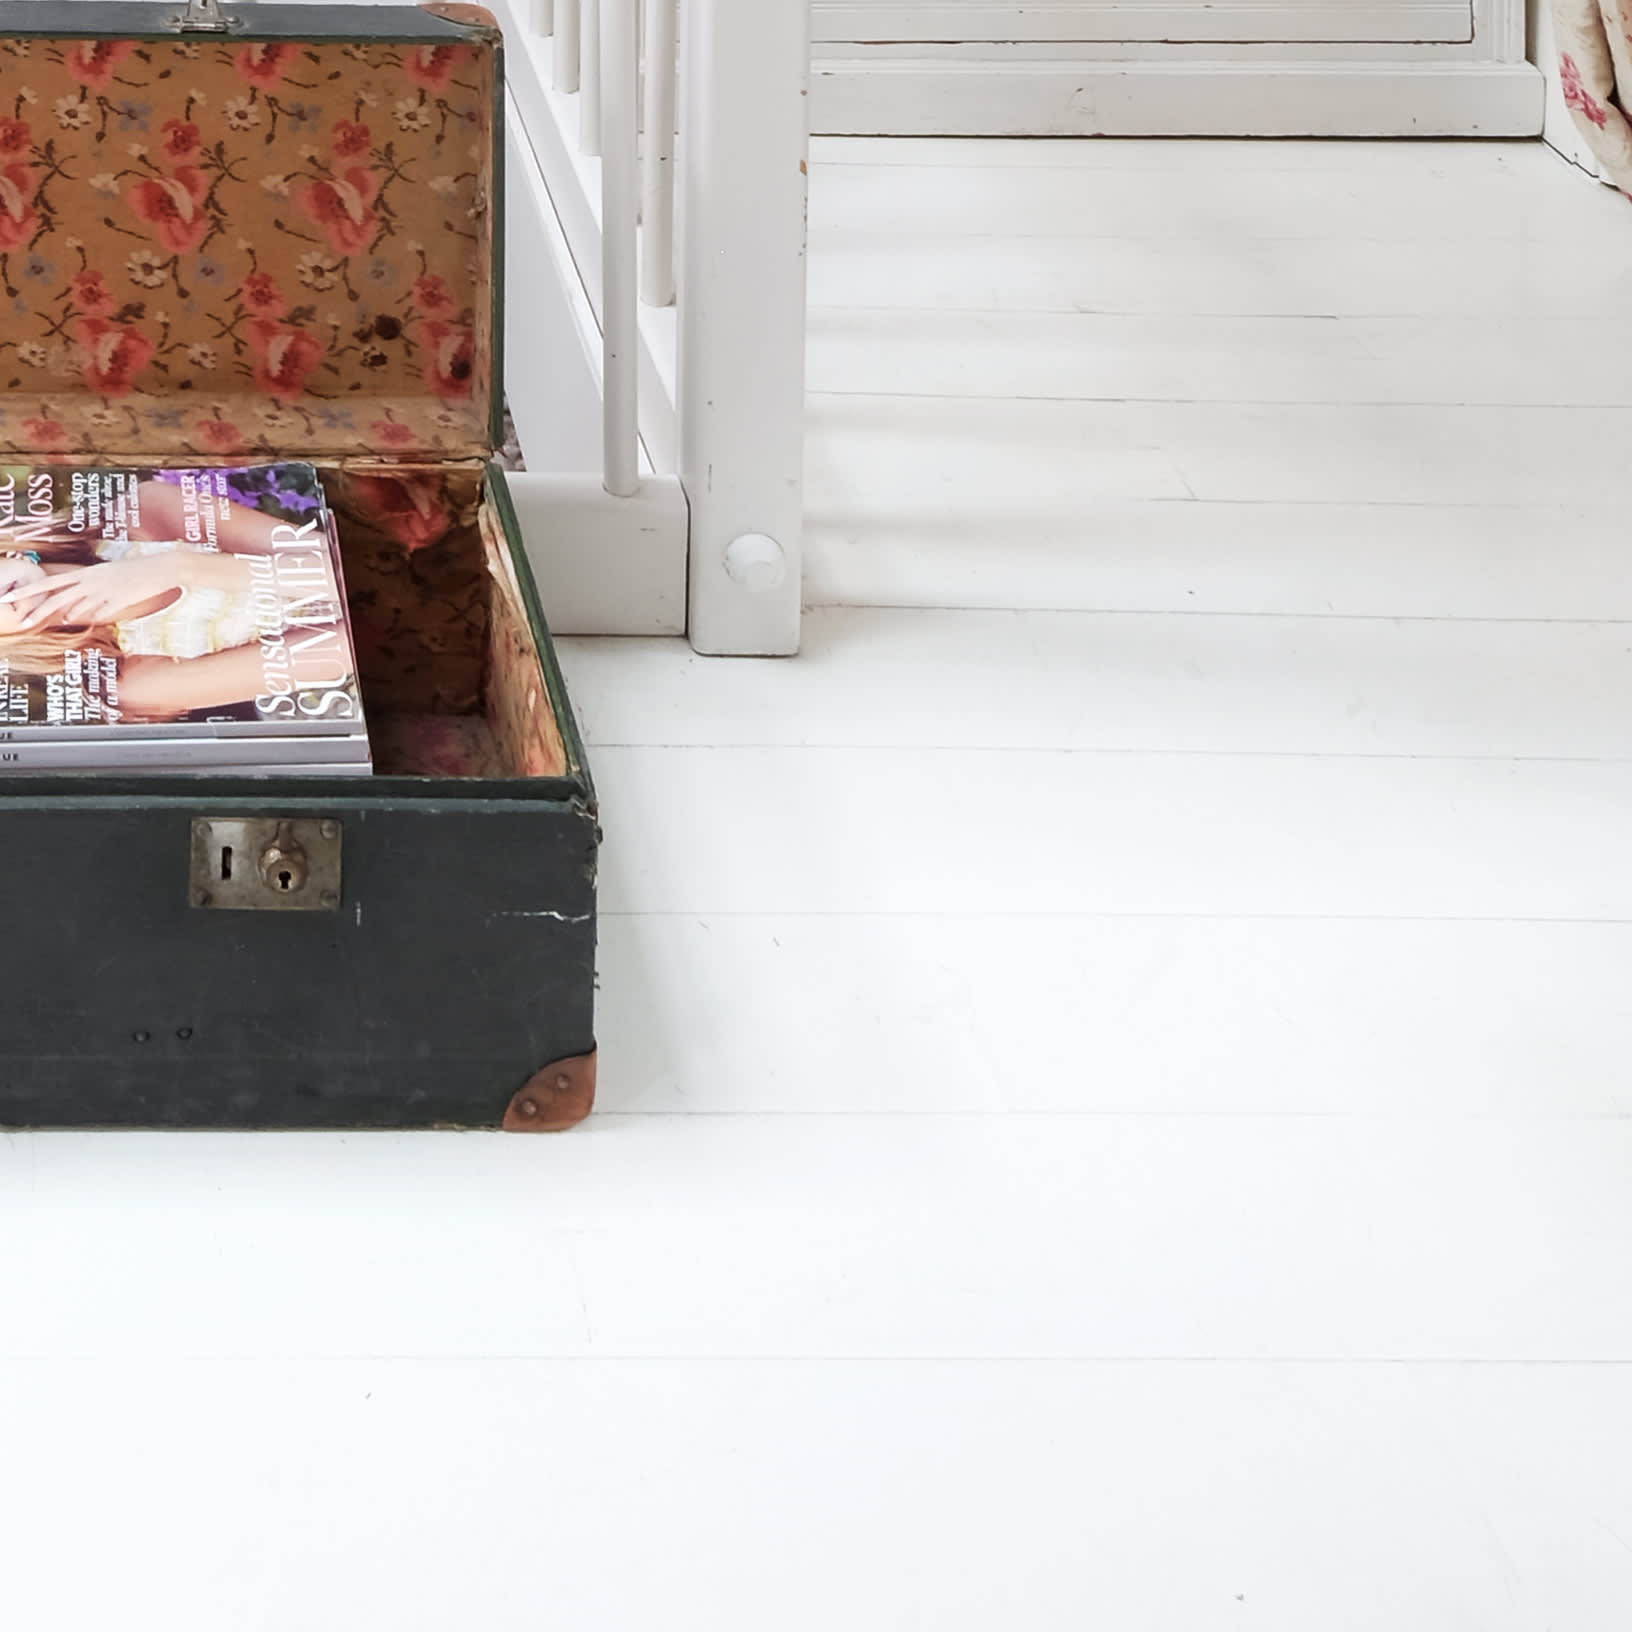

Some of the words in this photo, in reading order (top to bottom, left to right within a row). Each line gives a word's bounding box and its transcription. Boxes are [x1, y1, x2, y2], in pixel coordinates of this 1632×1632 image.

[13, 472, 54, 542] Moss
[67, 471, 86, 531] One-stop
[84, 472, 101, 526] wonders
[179, 475, 198, 511] RACER
[197, 474, 213, 503] One's
[182, 513, 201, 541] GIRL
[199, 504, 219, 551] Formula
[233, 551, 296, 717] Sensational
[270, 518, 354, 720] SUMMER
[64, 648, 82, 684] GIRL?
[83, 647, 103, 692] making
[100, 657, 118, 693] model
[8, 683, 29, 721] LIFE
[45, 674, 64, 720] WHO'S
[65, 686, 83, 720] THAT
[83, 694, 101, 719] The
[102, 706, 123, 720] of
